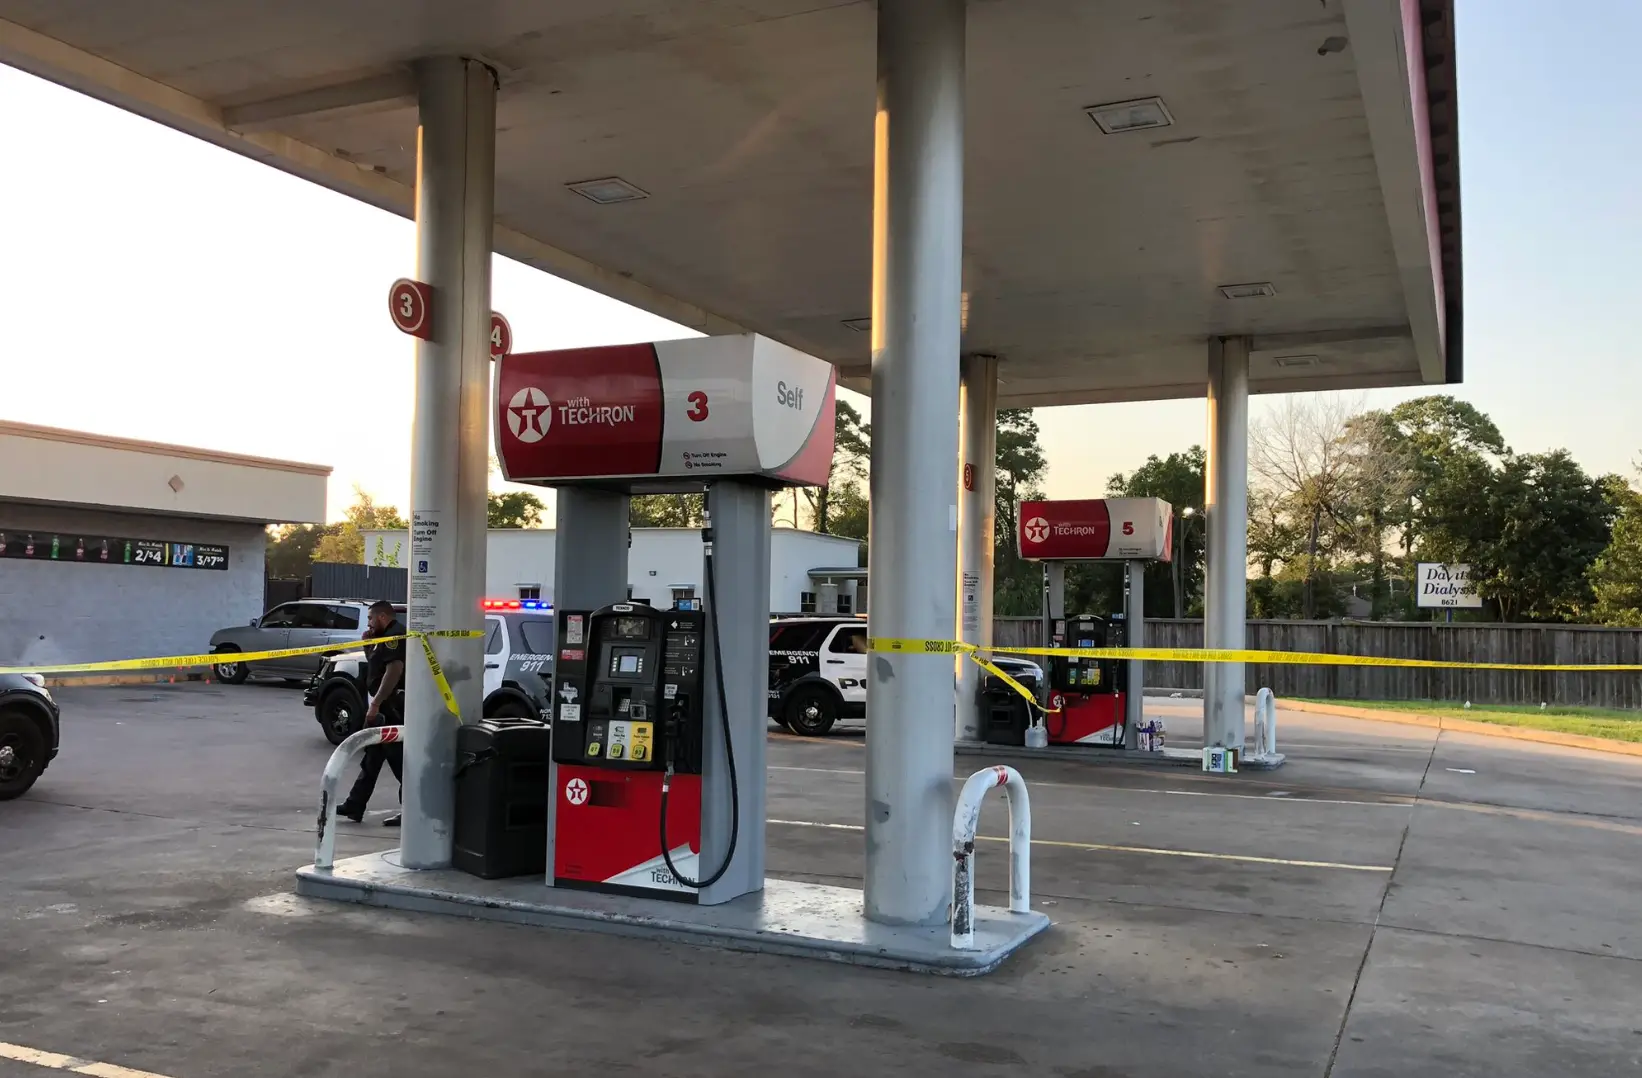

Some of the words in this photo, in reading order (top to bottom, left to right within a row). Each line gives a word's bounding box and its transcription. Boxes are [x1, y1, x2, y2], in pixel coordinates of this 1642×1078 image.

[400, 292, 413, 317] 3
[490, 325, 502, 348] 4
[777, 380, 803, 411] Self
[566, 396, 590, 408] with
[686, 391, 709, 422] 3
[558, 405, 635, 426] TECHRON
[1053, 526, 1095, 536] TECHRON
[1122, 521, 1134, 535] 5
[925, 641, 944, 652] CROSS
[509, 653, 553, 661] EMERGEN
[788, 656, 810, 664] 911
[519, 660, 545, 671] 911
[656, 866, 670, 874] with
